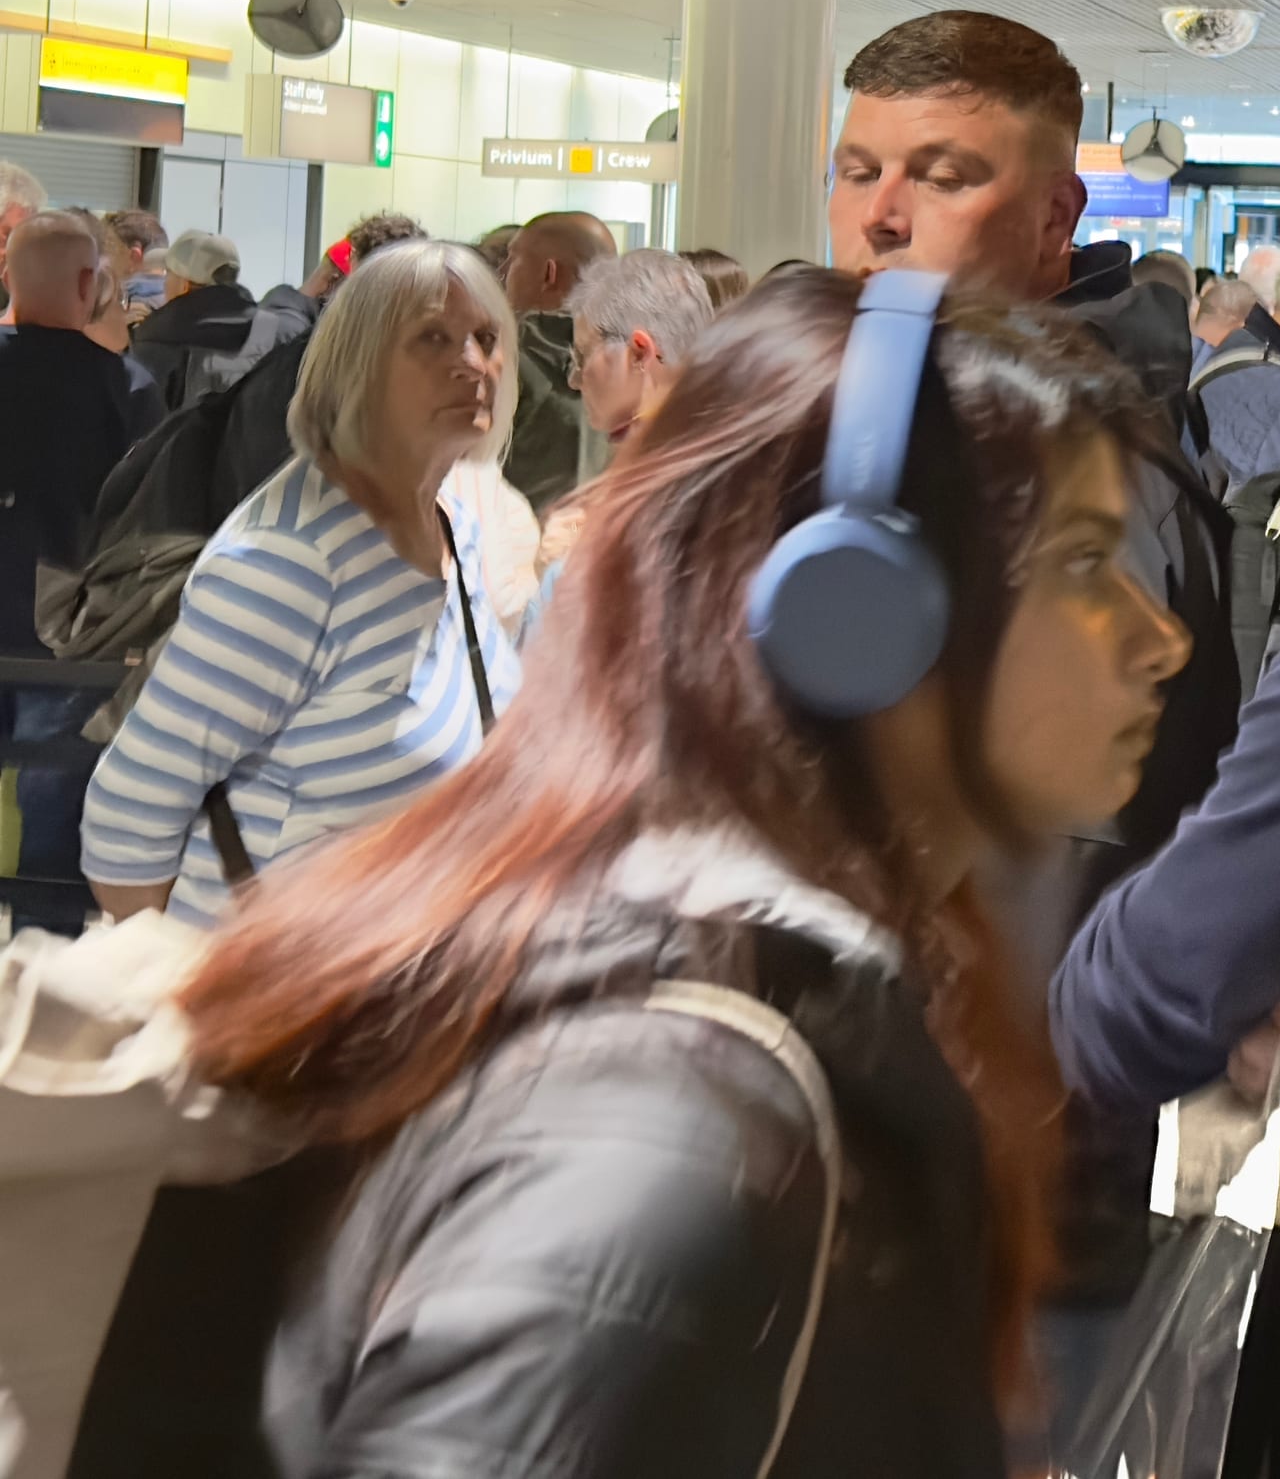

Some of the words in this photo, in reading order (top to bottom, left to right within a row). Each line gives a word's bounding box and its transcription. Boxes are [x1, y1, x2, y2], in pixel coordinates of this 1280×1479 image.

[284, 80, 305, 98] Staff
[305, 84, 325, 105] only
[489, 148, 553, 166] Privium
[607, 152, 652, 169] Crew
